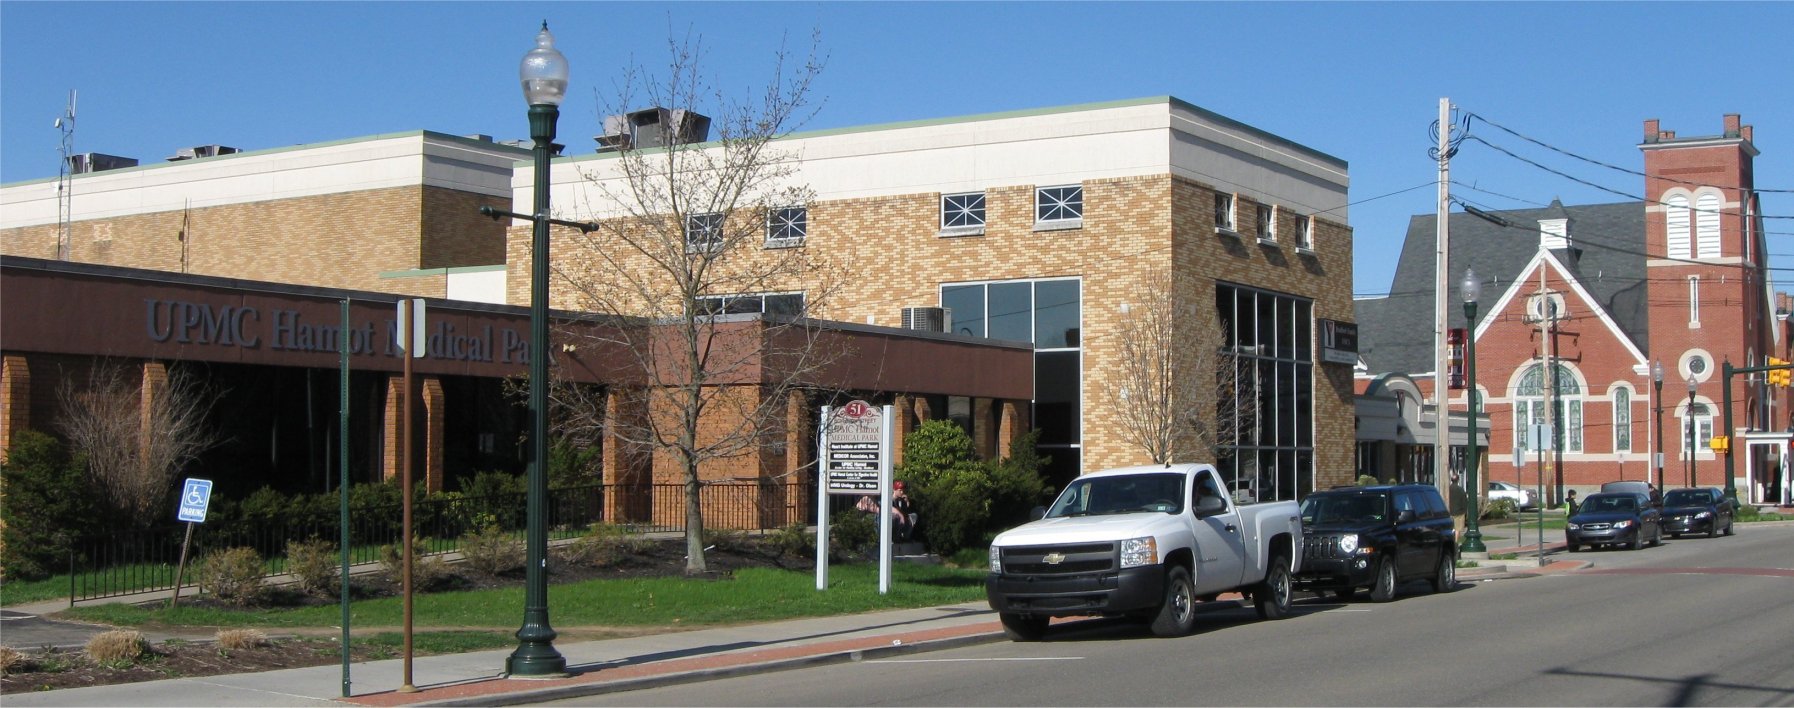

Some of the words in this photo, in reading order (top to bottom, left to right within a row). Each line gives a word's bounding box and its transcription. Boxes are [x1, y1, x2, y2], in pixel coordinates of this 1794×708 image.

[146, 300, 260, 348] UPMC
[272, 309, 374, 354] Hamot
[385, 319, 493, 361] Mdical
[502, 328, 559, 368] Pa
[850, 404, 860, 414] 51
